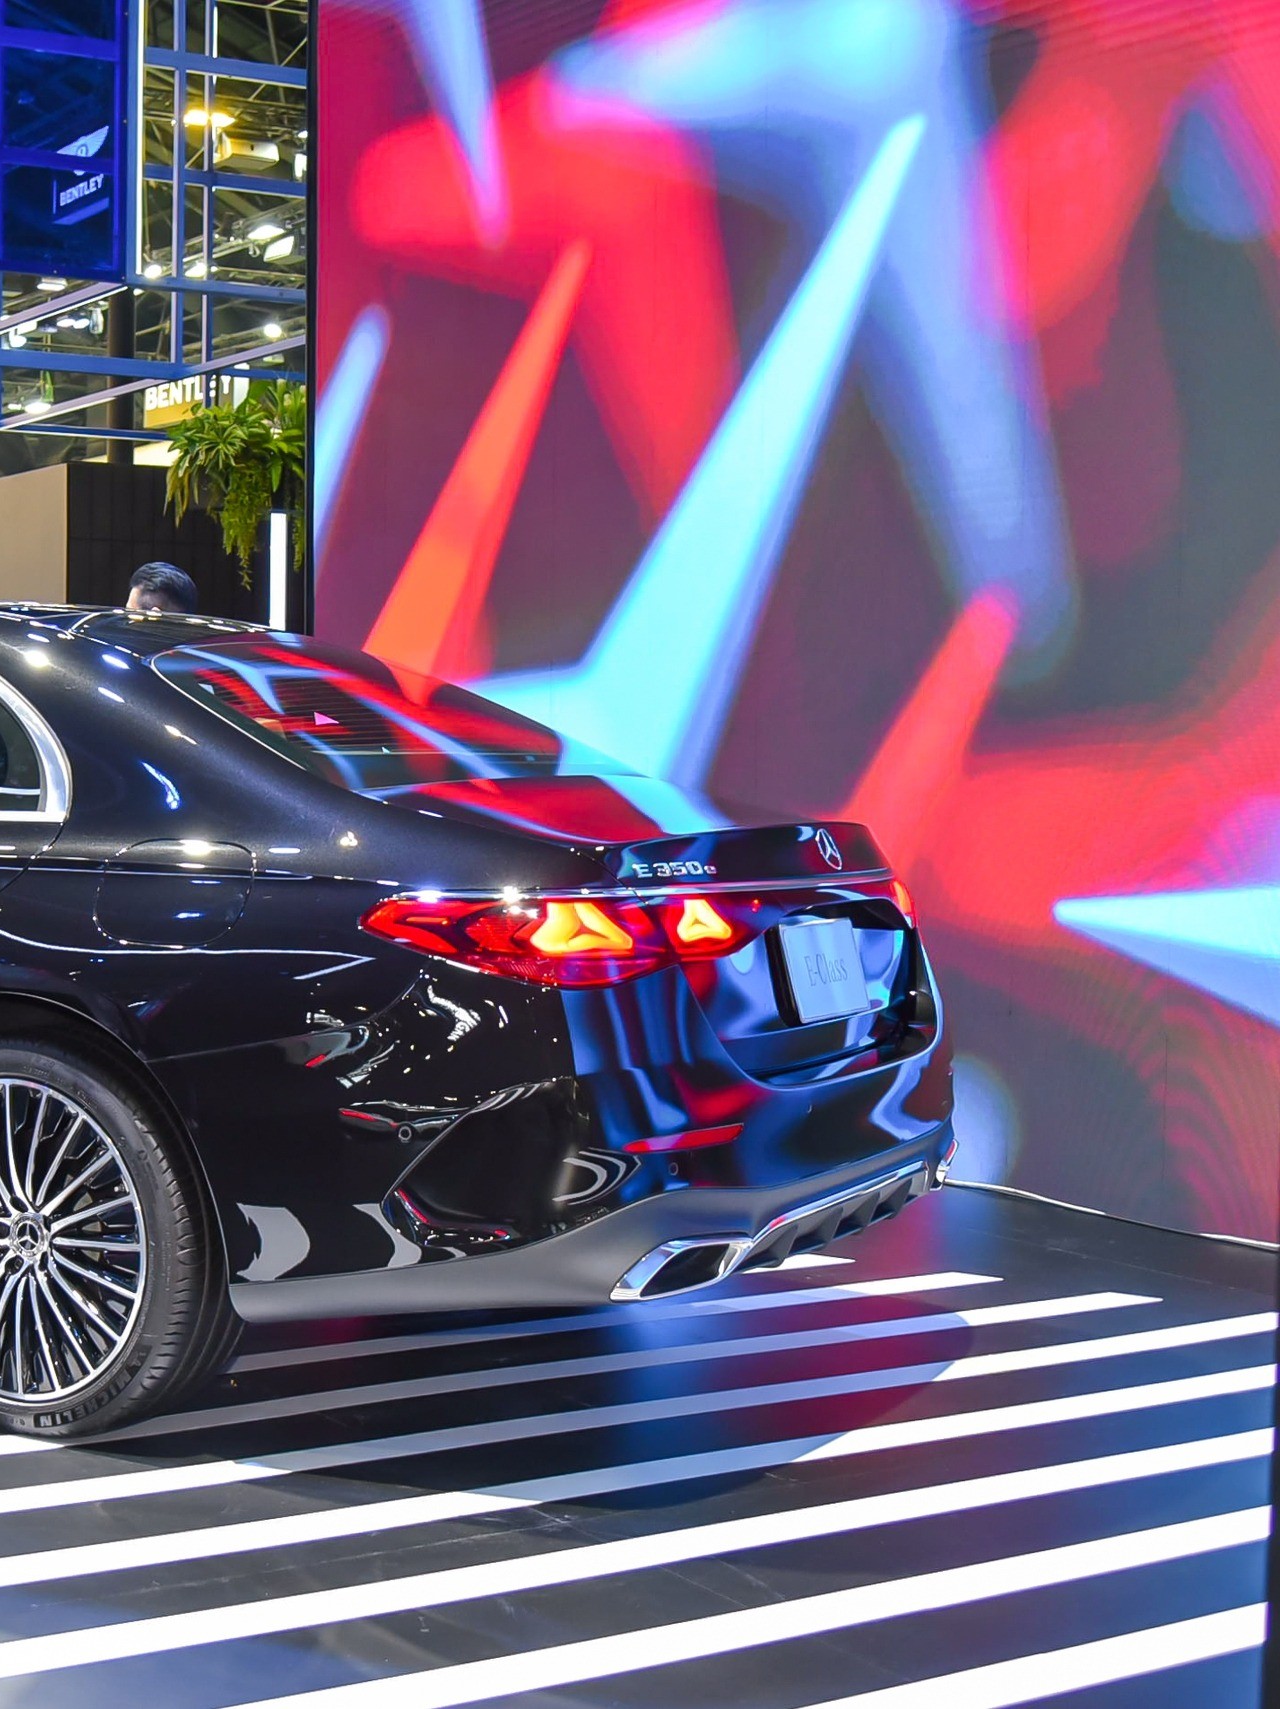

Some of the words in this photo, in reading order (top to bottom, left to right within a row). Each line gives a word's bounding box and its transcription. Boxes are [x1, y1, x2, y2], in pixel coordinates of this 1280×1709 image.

[59, 173, 105, 207] BENTLEY
[631, 863, 653, 879] E
[803, 953, 849, 988] E-Class
[38, 1367, 134, 1428] MICHELIN
